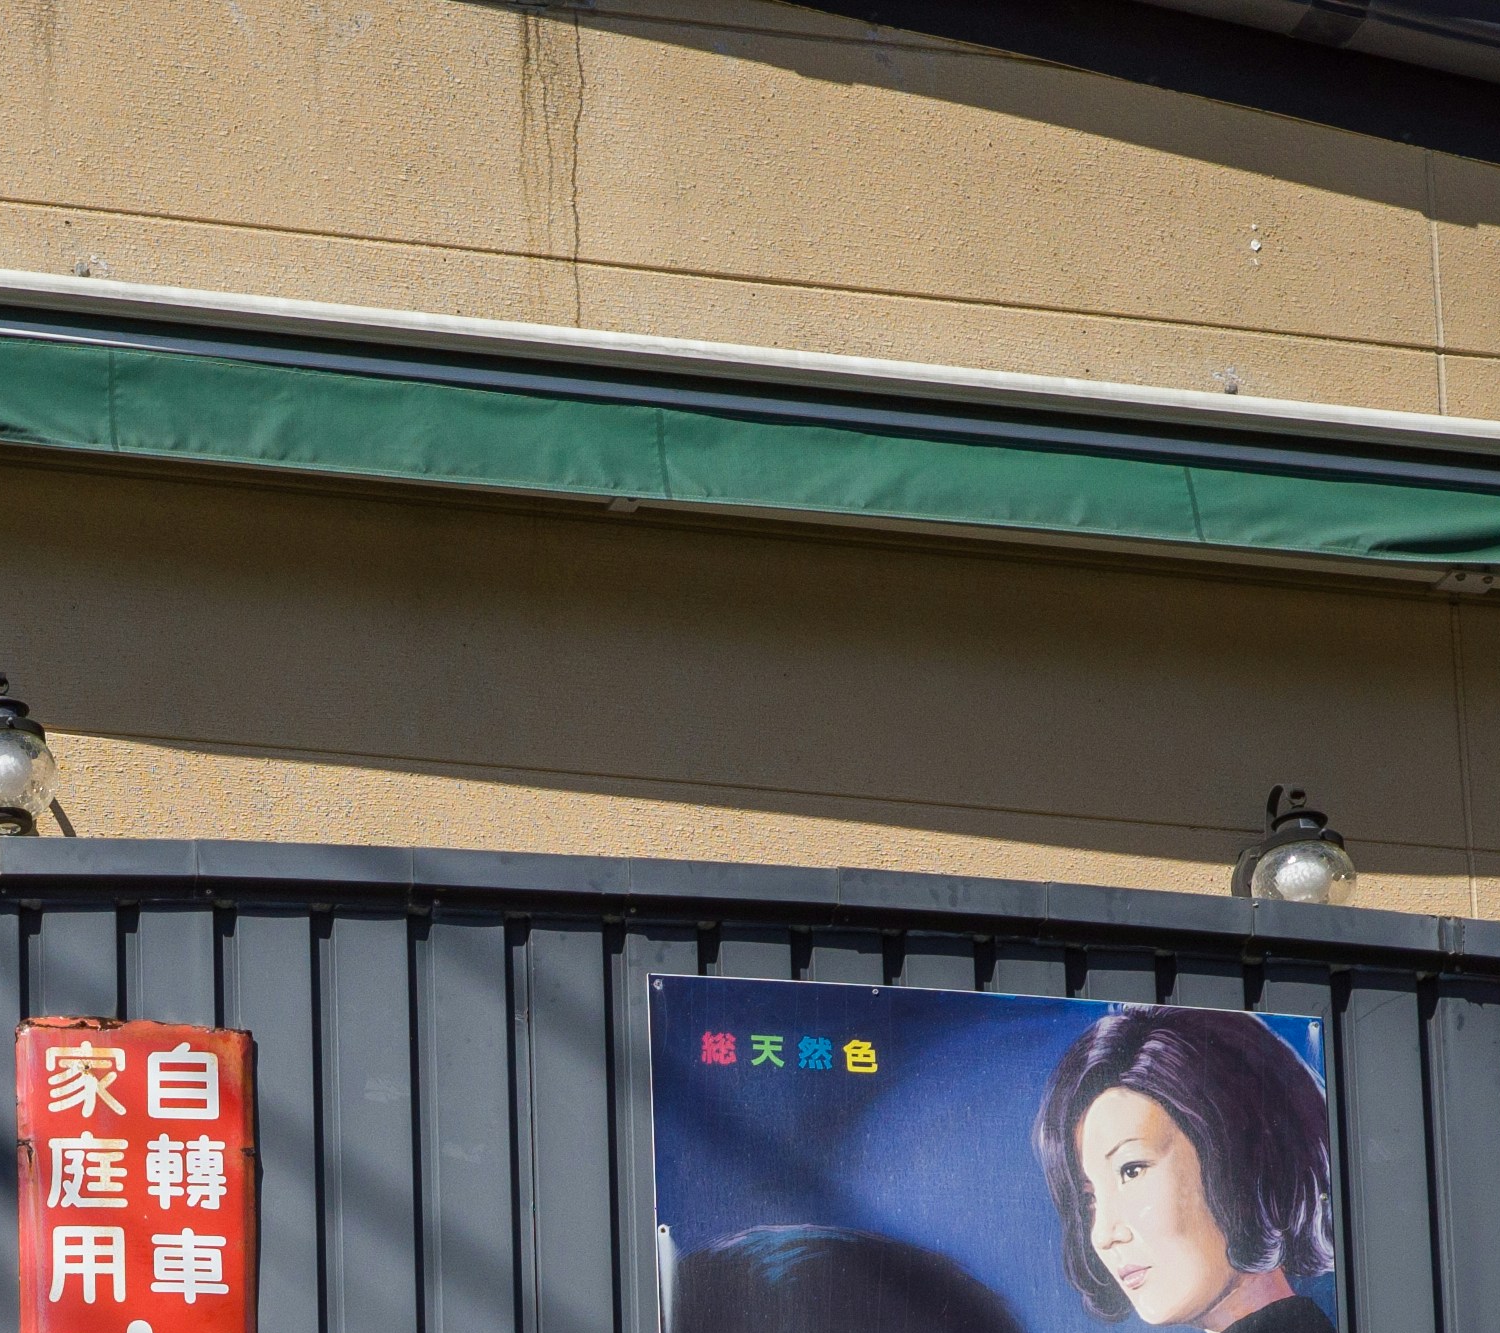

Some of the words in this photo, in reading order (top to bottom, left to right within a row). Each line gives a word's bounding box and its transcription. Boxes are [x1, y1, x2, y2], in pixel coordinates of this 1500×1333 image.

[701, 1030, 878, 1073] 総天然色
[45, 1041, 128, 1304] 家庭用
